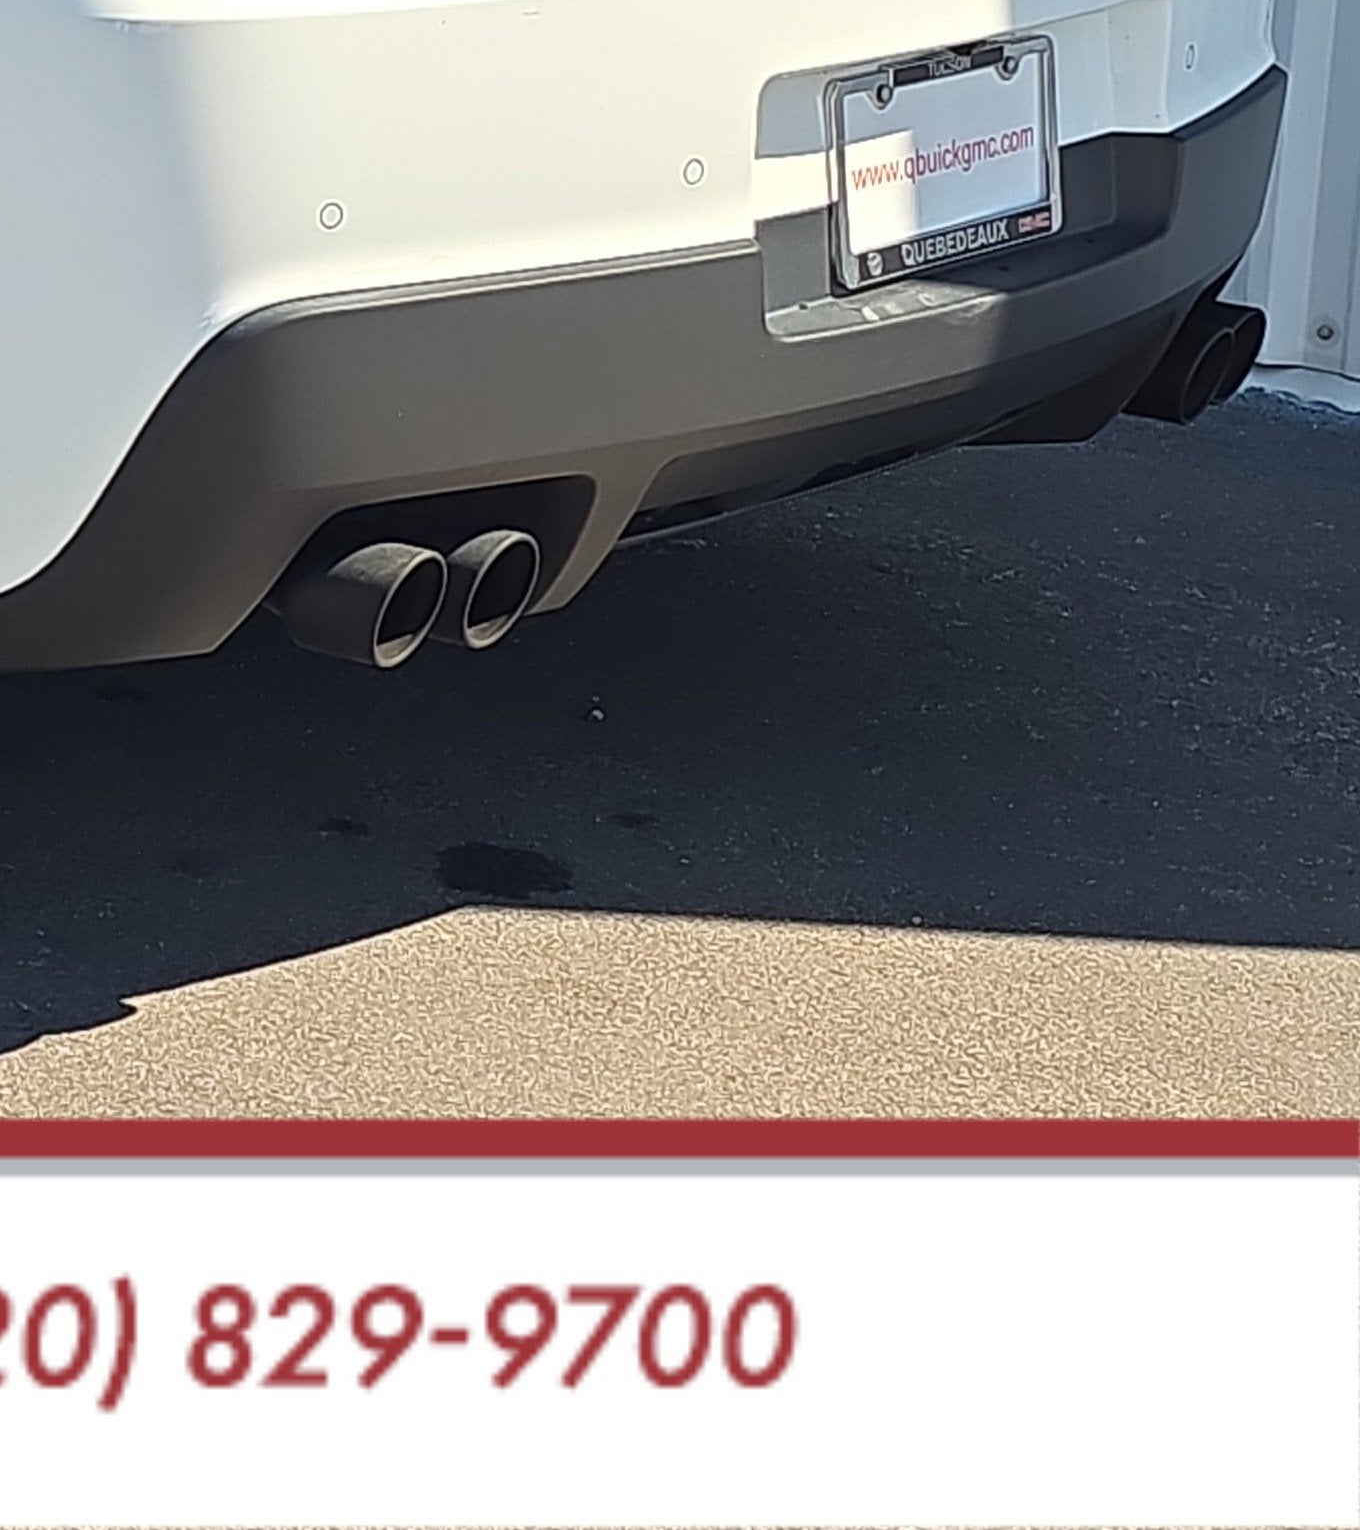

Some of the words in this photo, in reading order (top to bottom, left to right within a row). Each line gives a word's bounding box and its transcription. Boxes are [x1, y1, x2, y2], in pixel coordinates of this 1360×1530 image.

[928, 55, 972, 77] TUCSON
[851, 126, 1034, 190] www.qbuickgmc.com
[900, 220, 1010, 267] QUEBEDEAUX
